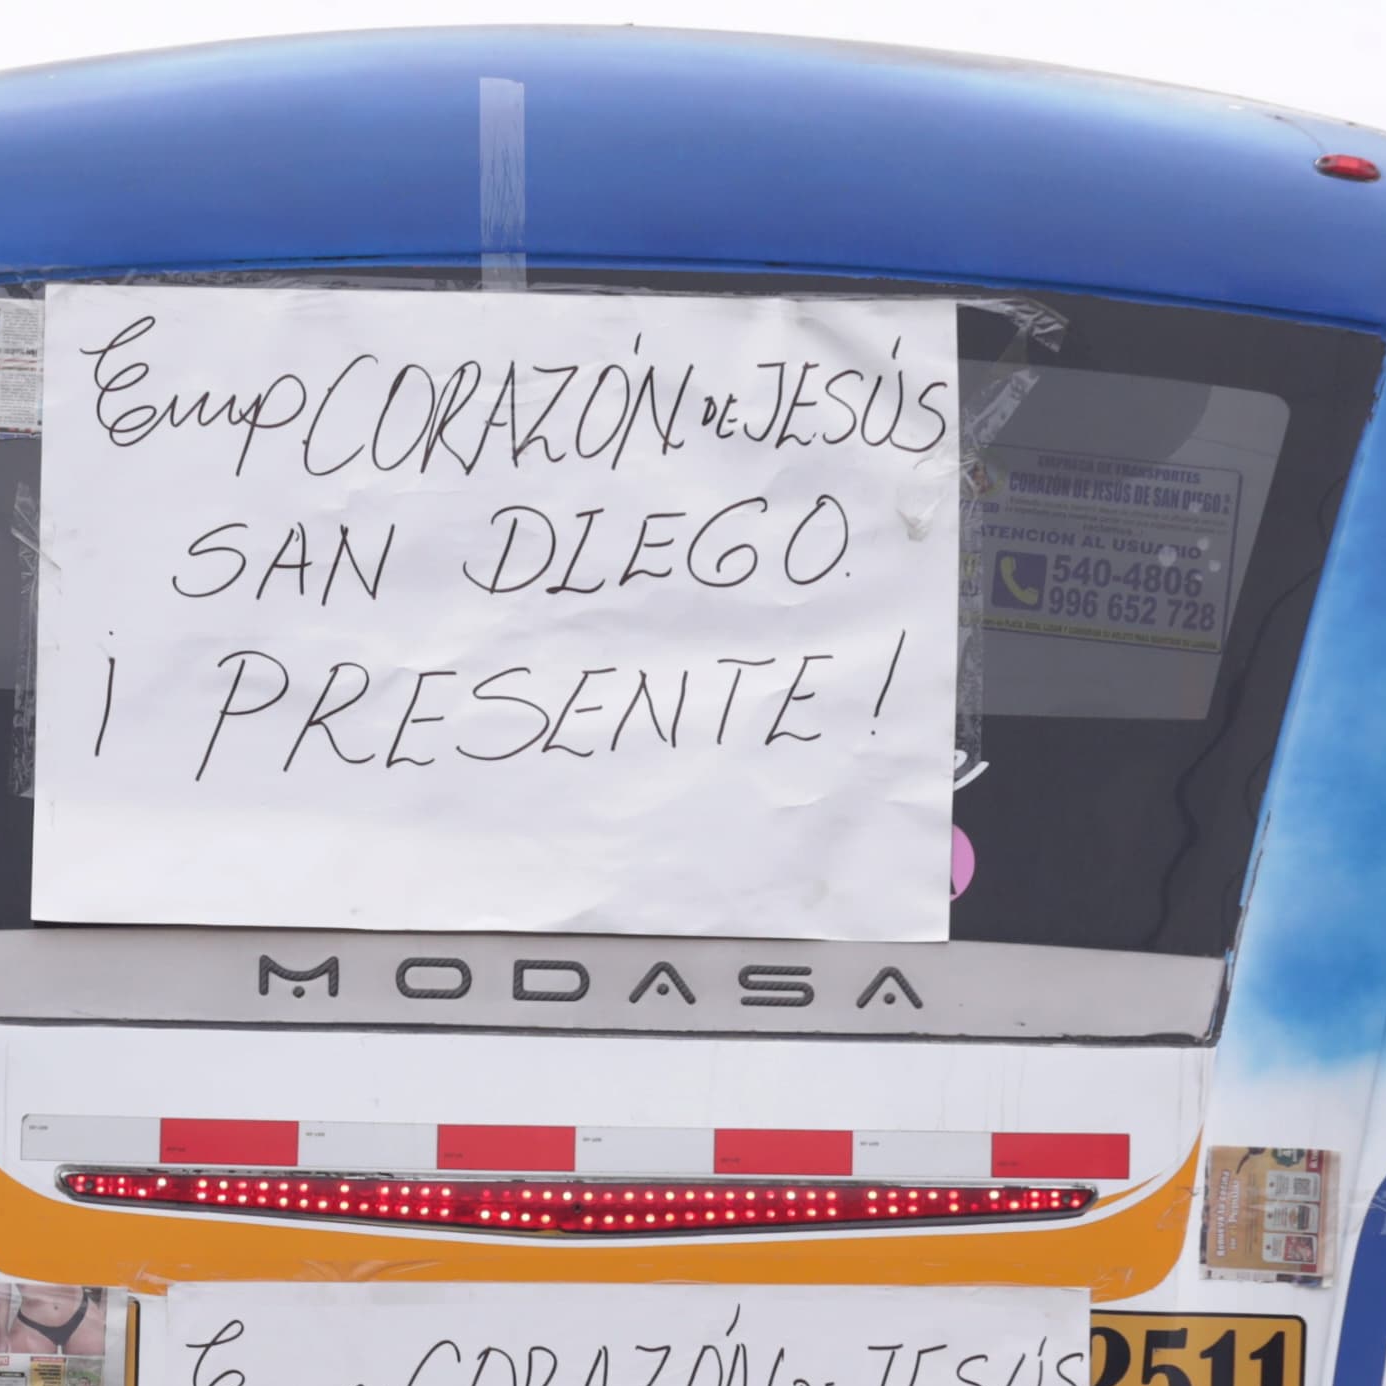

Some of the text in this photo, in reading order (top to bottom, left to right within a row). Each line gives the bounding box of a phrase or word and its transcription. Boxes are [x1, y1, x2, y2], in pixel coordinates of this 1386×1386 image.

[304, 333, 695, 476] CORAZÓN
[744, 336, 948, 453] JESÚS
[1008, 470, 1072, 497] CORAZÓN
[1072, 479, 1090, 500] DE
[1133, 485, 1152, 508] DE
[1152, 488, 1180, 511] SAN
[1113, 461, 1202, 485] TRANSPORTES
[172, 521, 397, 606] SAN
[1081, 534, 1105, 550] AL
[1052, 554, 1203, 598] 540-4806
[1048, 586, 1216, 632] 996 652 728
[258, 953, 924, 1011] MODASA
